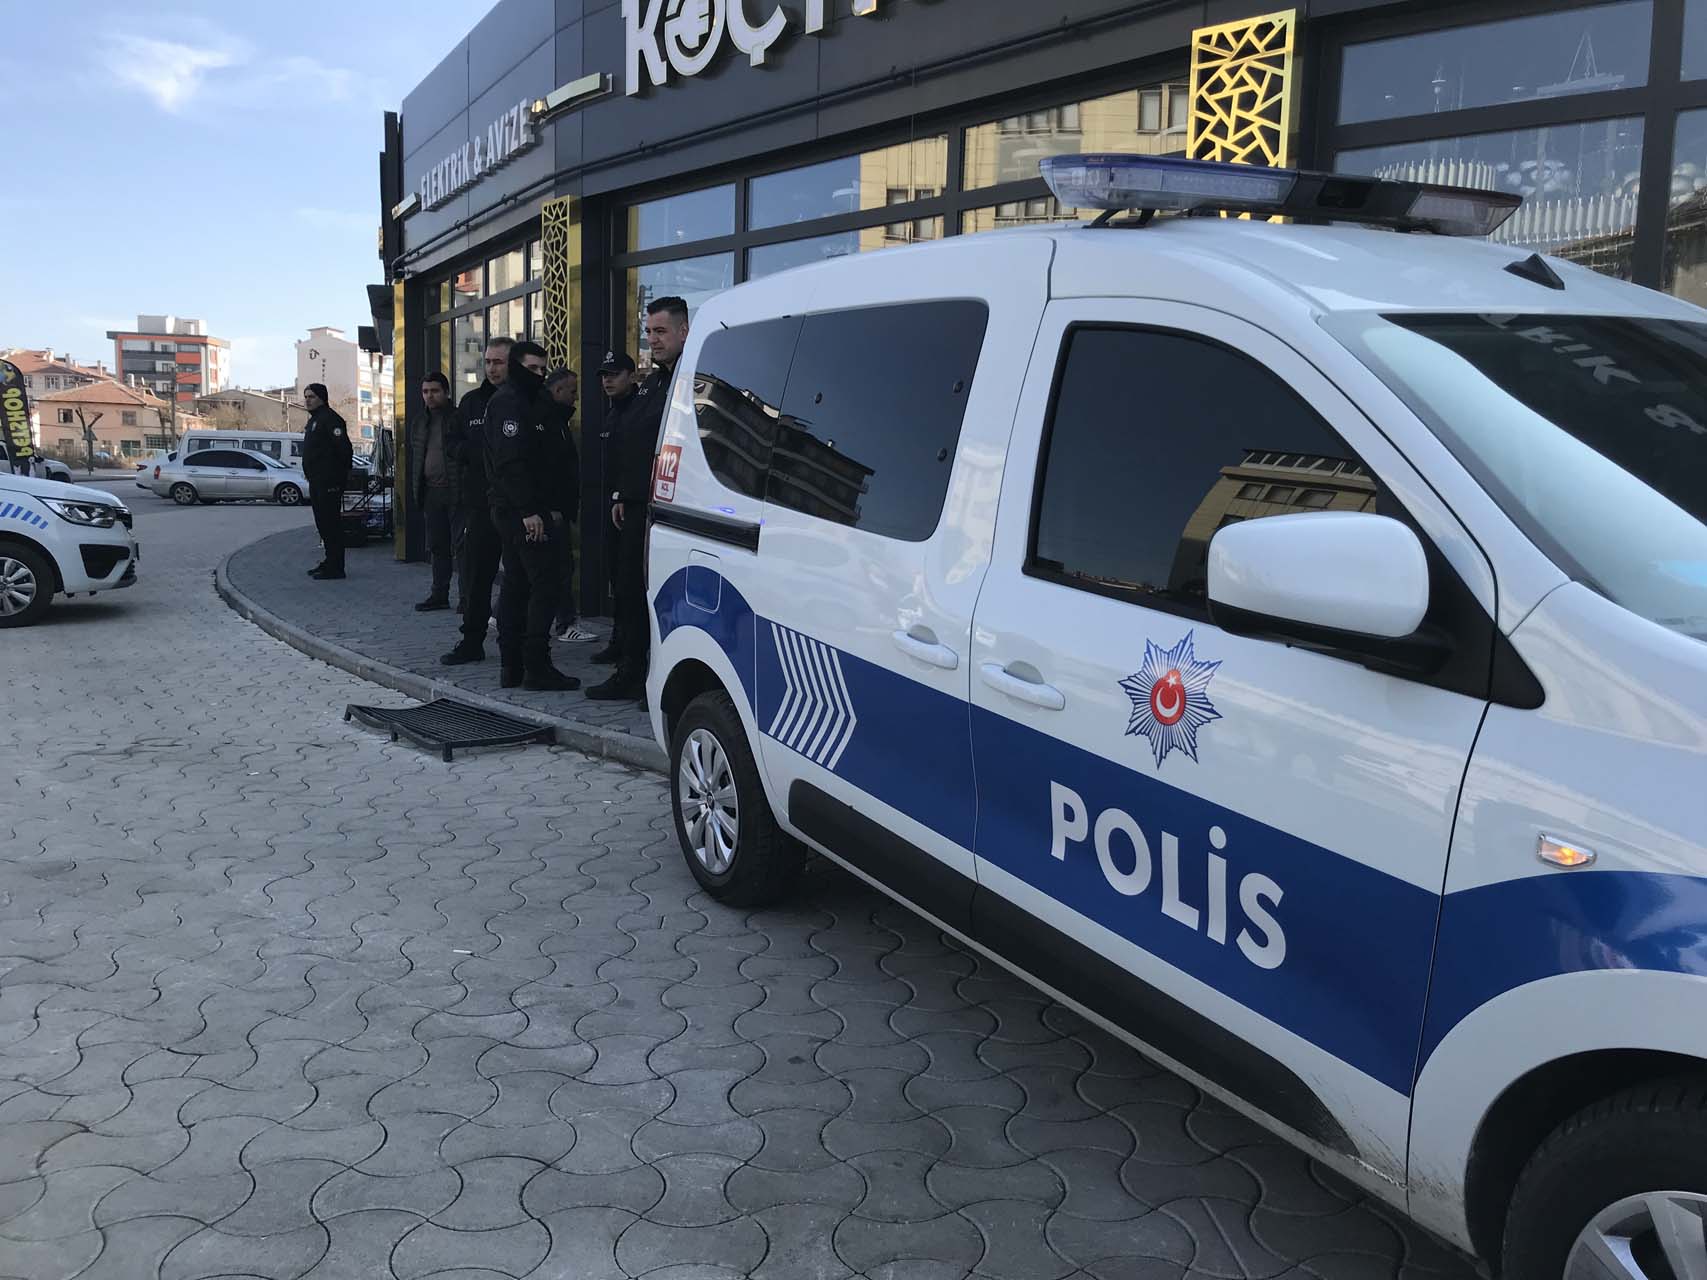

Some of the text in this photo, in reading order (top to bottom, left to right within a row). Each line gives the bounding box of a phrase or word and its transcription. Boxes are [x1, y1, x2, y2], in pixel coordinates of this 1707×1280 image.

[473, 135, 482, 175] &
[486, 97, 531, 168] AVİZE
[661, 451, 677, 478] 112
[1050, 780, 1286, 969] POLİS
